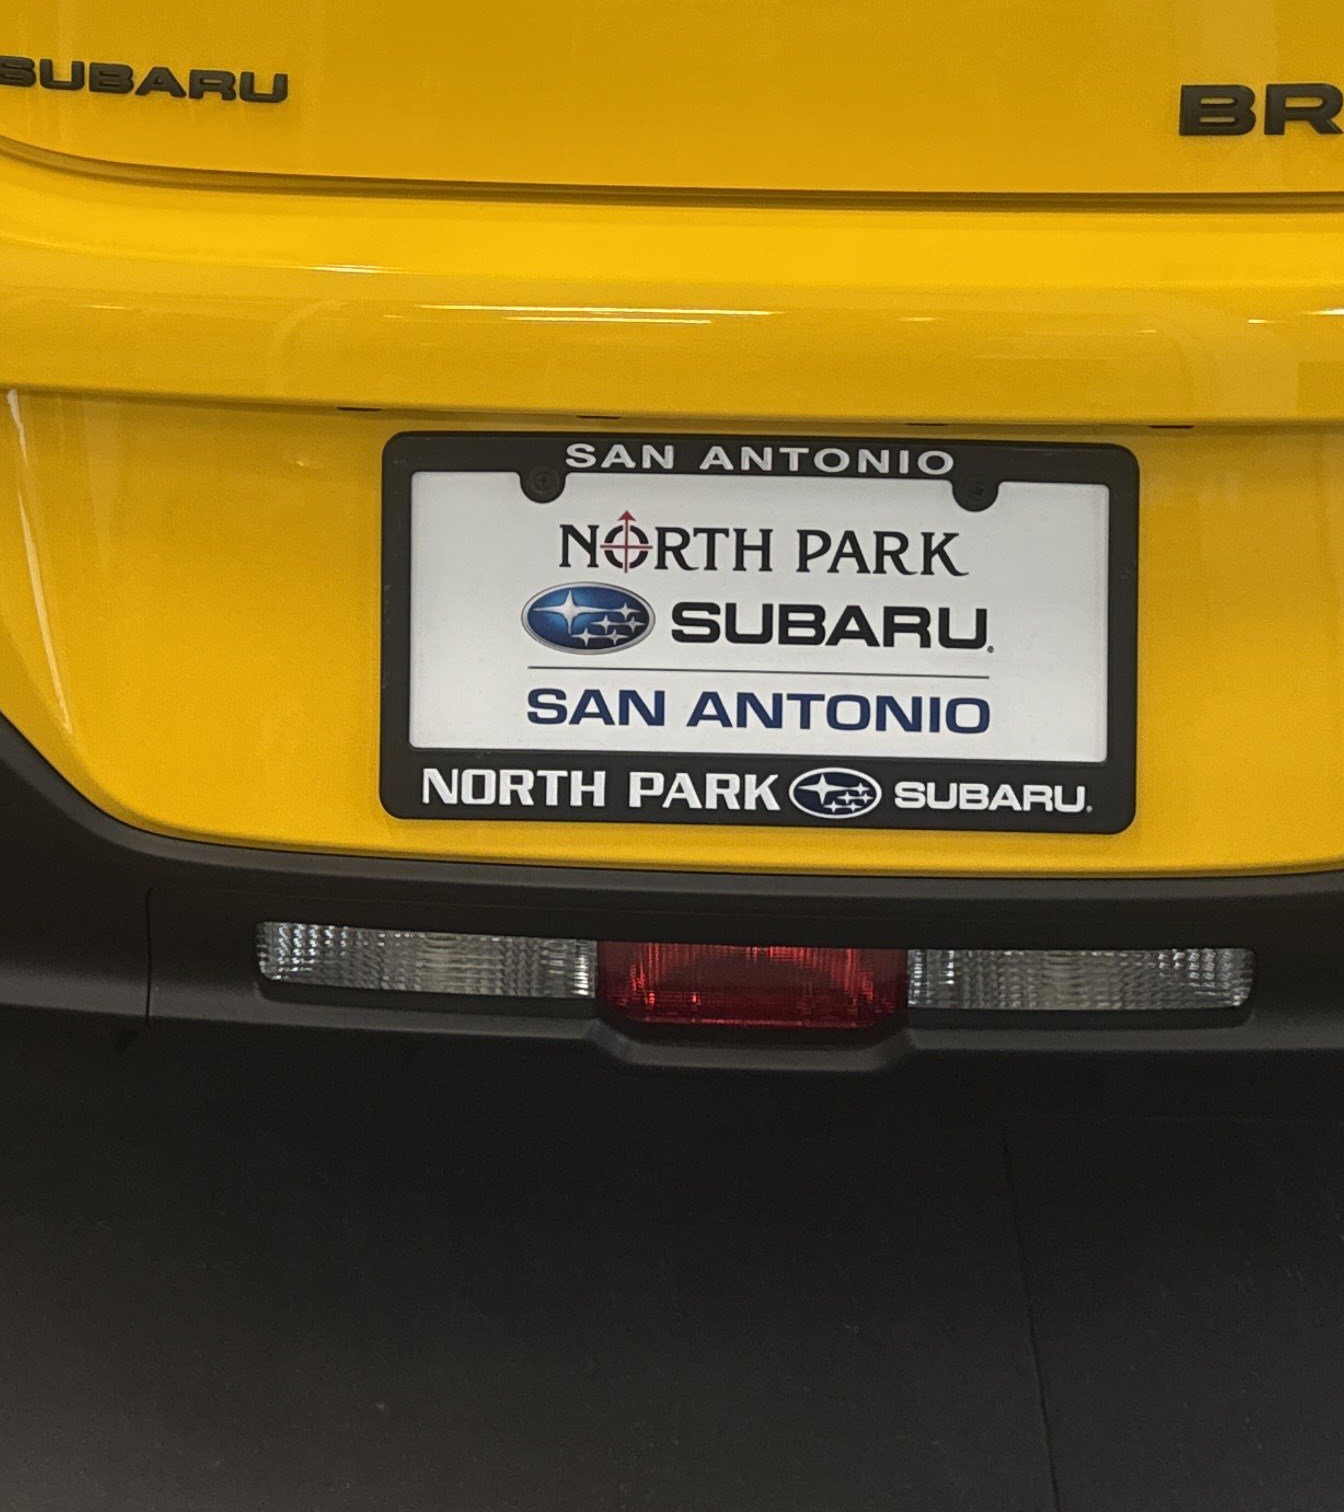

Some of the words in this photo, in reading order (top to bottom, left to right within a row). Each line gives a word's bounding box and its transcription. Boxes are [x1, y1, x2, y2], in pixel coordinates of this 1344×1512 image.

[566, 443, 674, 470] SAN
[699, 445, 955, 475] ANTONIO
[559, 522, 774, 573] NORTH
[796, 529, 970, 576] PARK
[671, 601, 988, 650] SUBARU
[527, 688, 666, 727] SAN
[686, 691, 991, 735] ANTONIO
[422, 767, 606, 807] NORTH
[628, 771, 781, 812] PARK
[894, 781, 1086, 814] SUBARU
